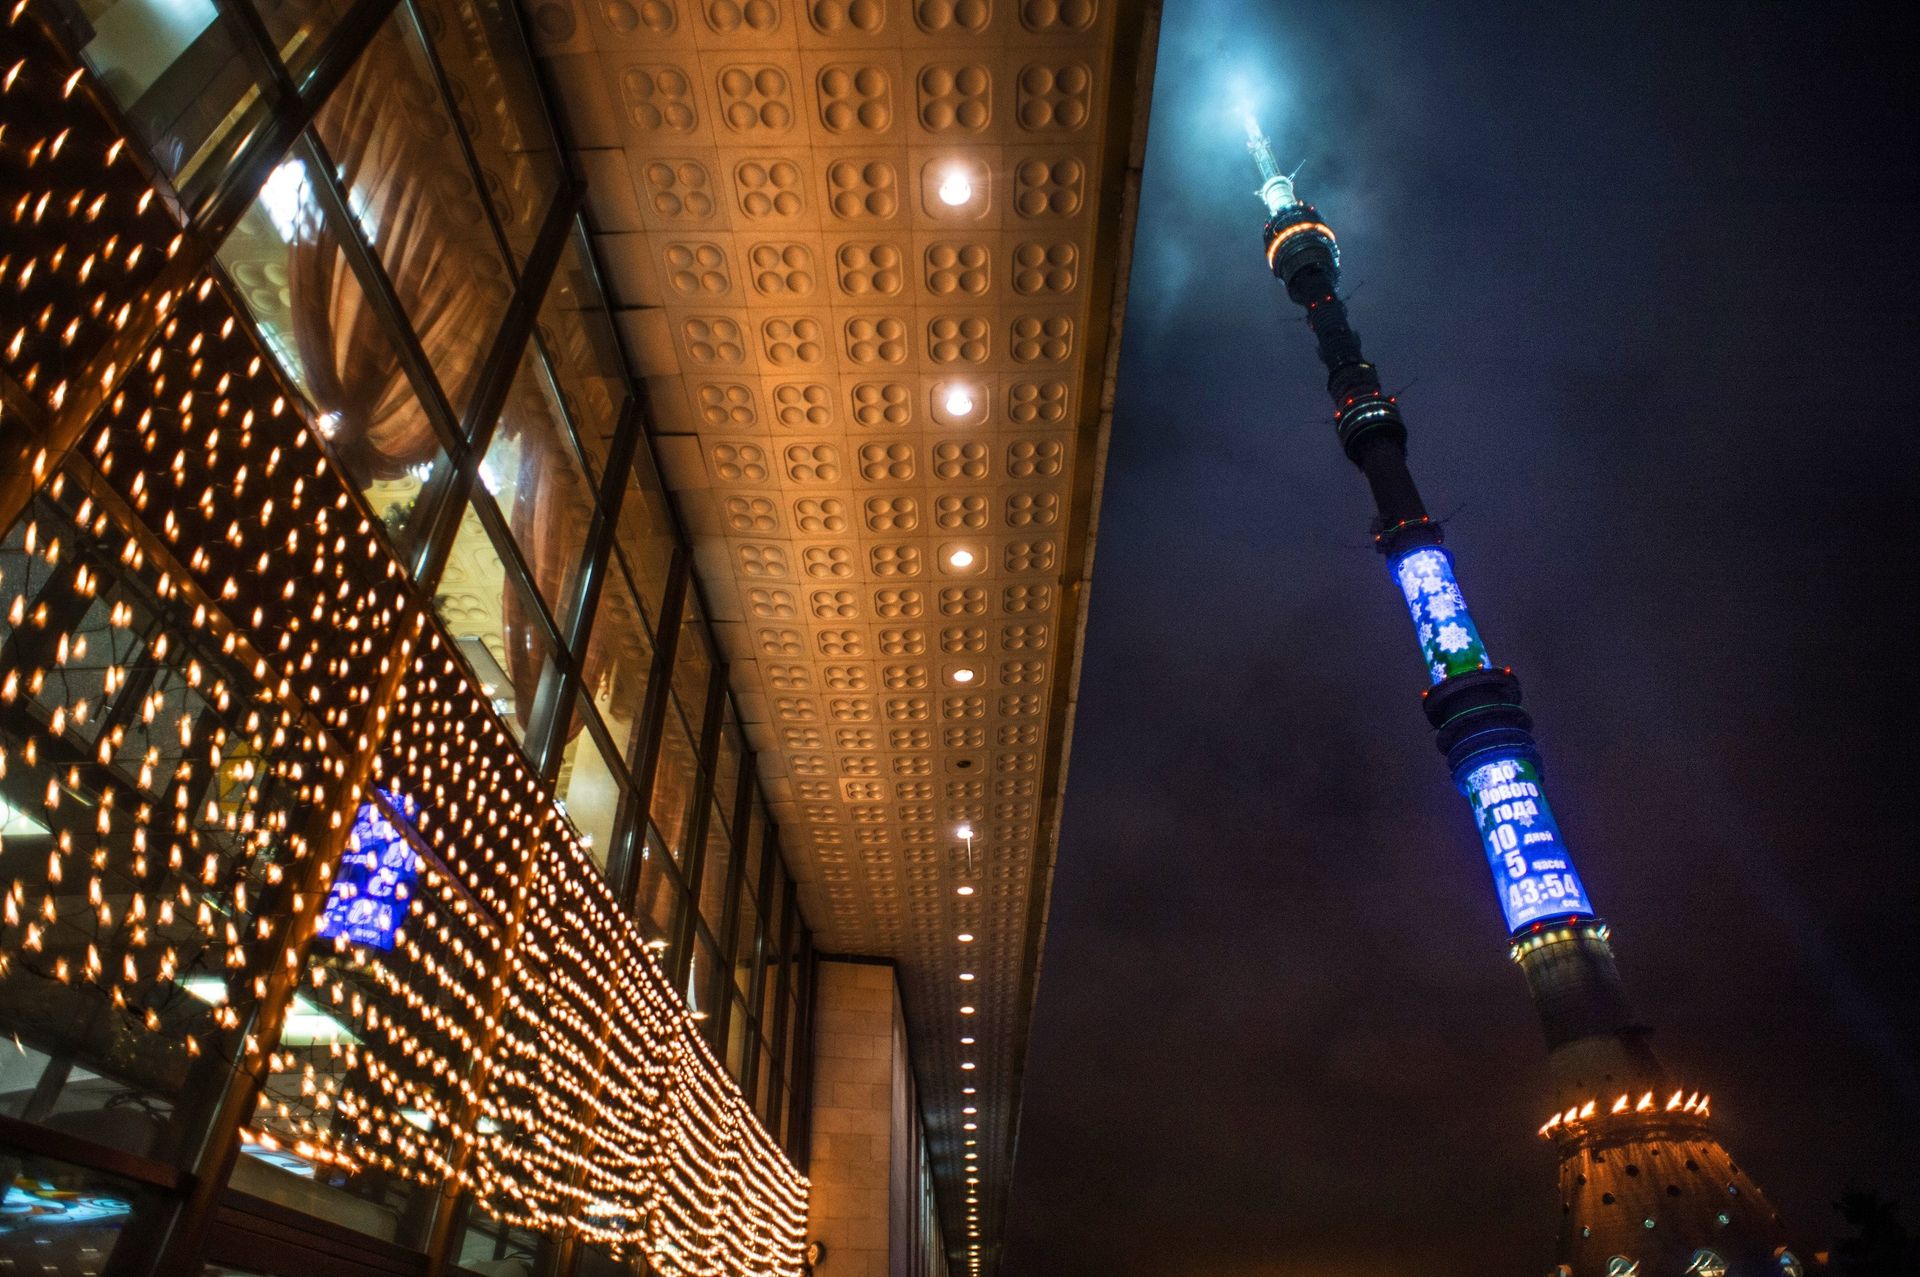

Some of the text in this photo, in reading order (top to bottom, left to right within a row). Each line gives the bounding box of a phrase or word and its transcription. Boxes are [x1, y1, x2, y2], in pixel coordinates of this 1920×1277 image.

[1488, 823, 1554, 855] 10 дней
[1504, 849, 1527, 879] 5
[1509, 873, 1580, 909] 43:54
